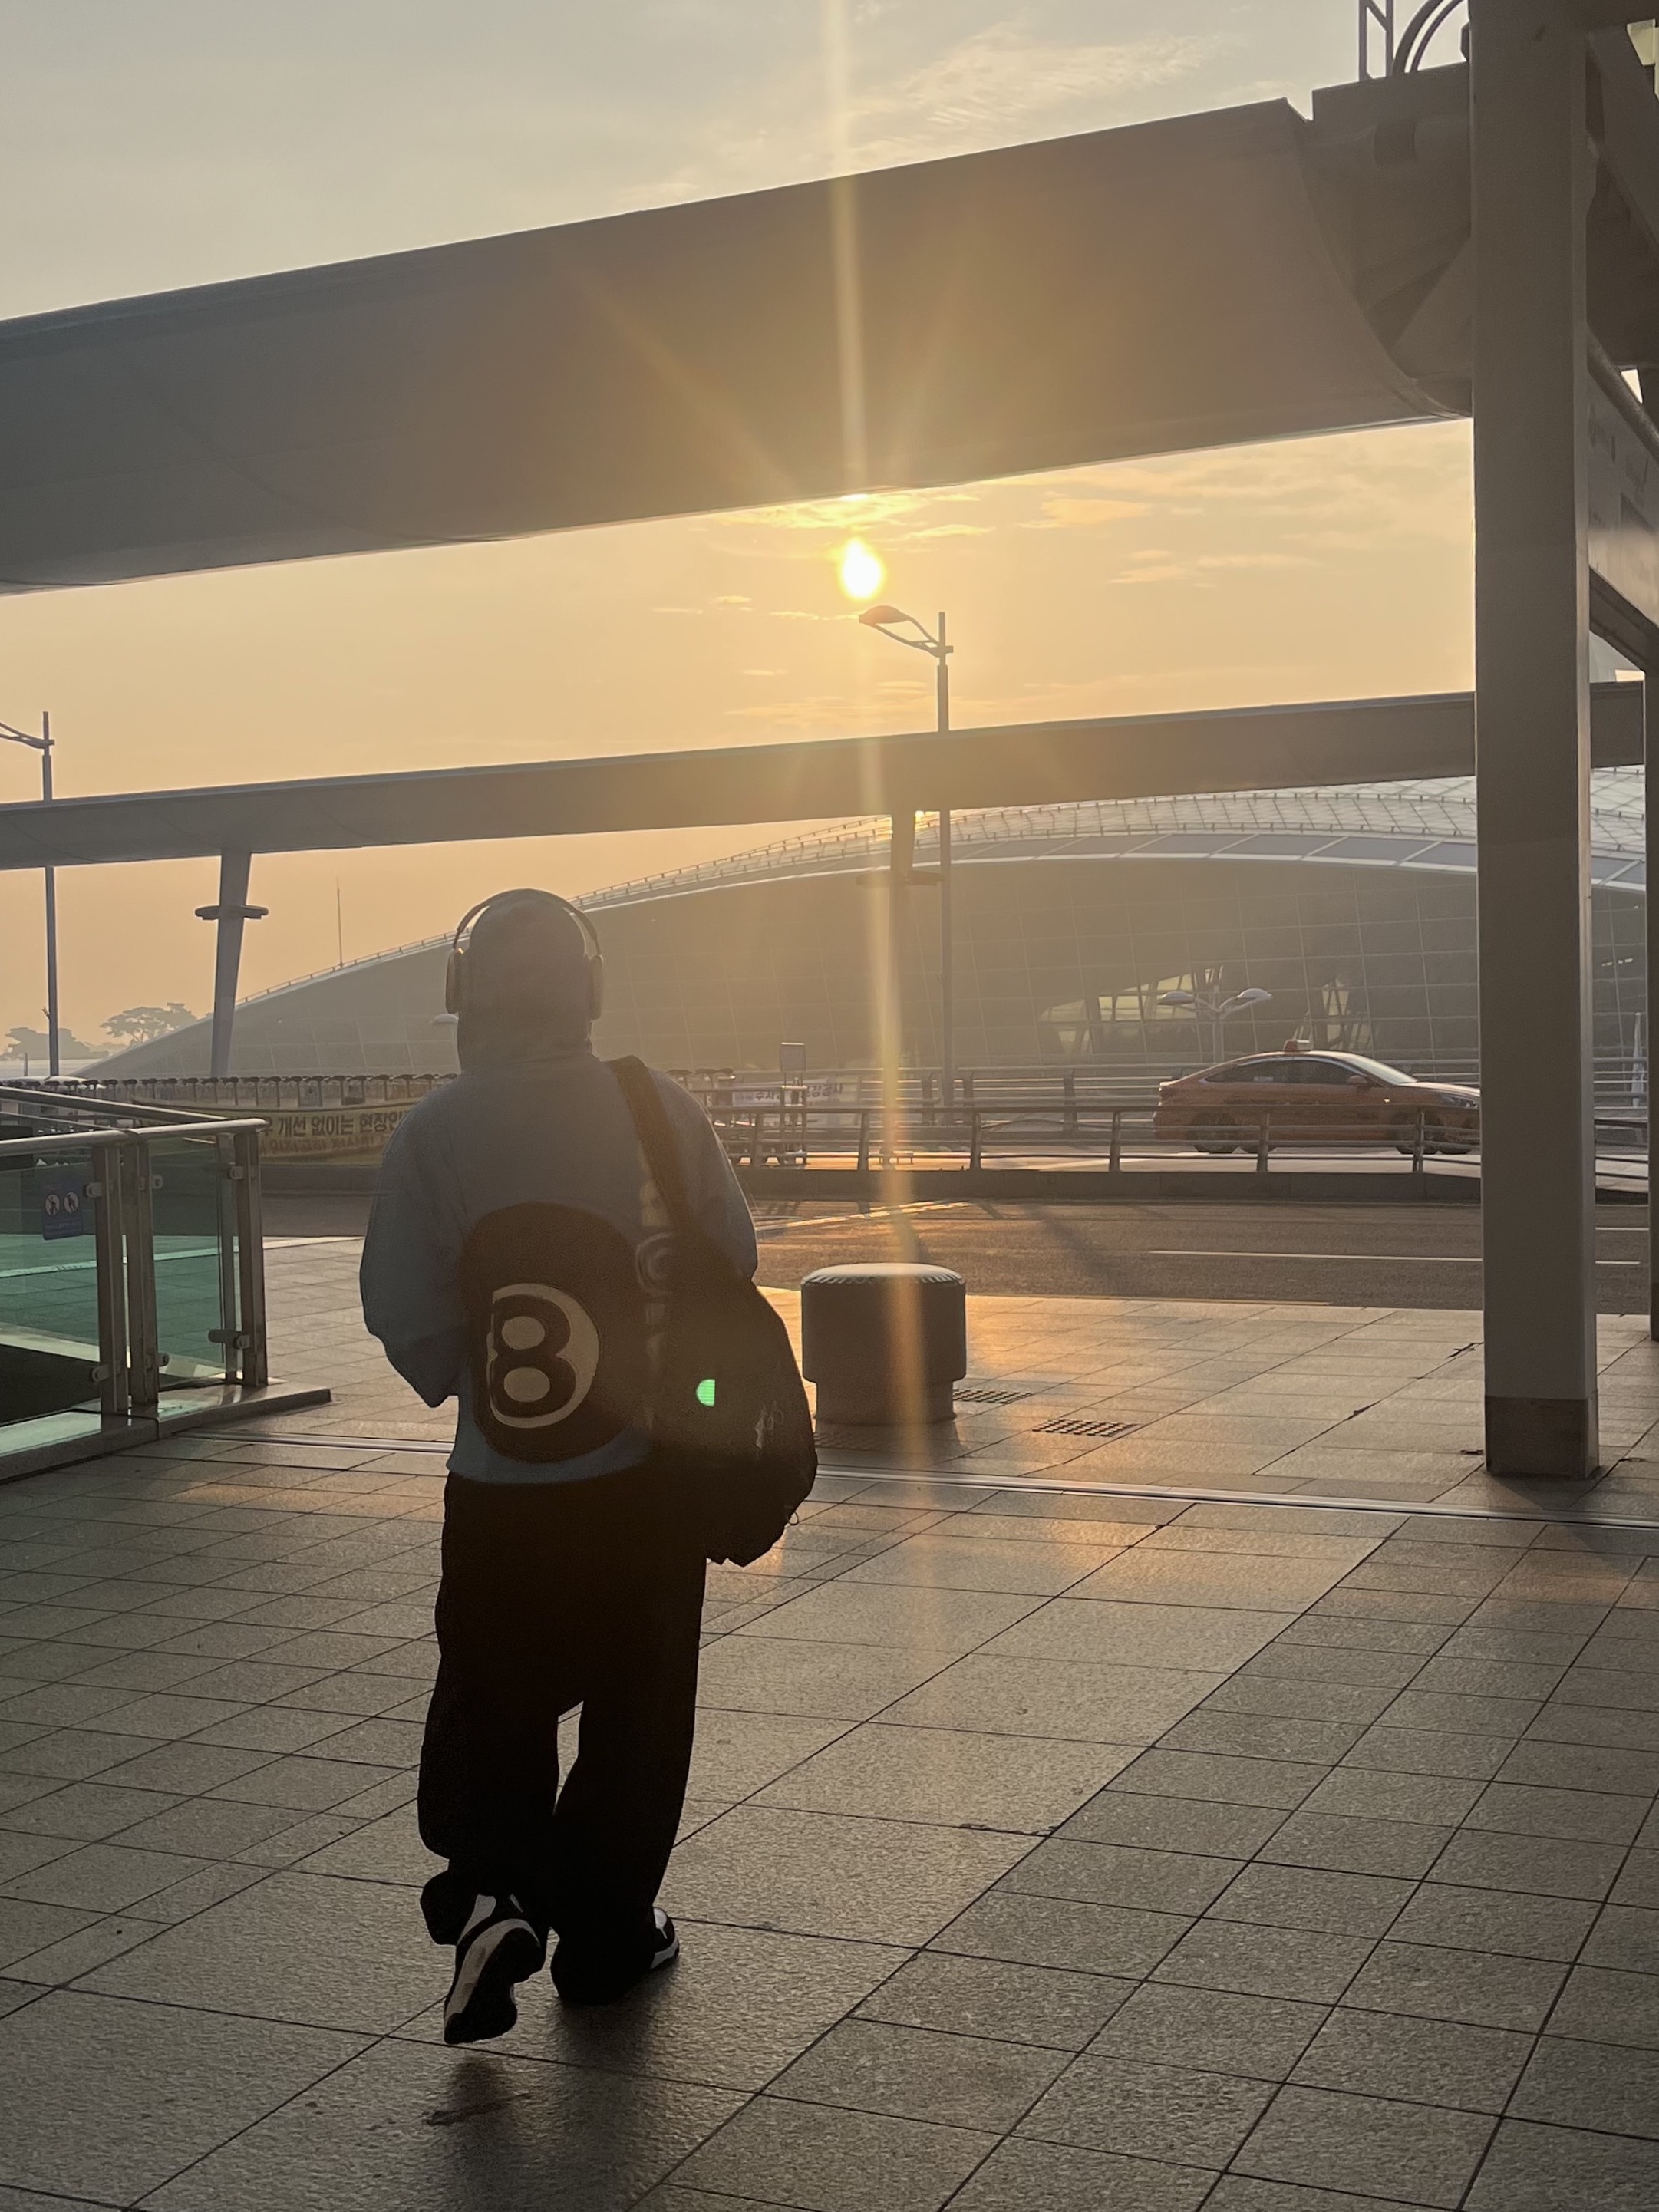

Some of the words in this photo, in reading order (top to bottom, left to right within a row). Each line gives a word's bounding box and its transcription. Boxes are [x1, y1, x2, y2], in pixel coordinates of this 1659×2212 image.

[278, 1116, 307, 1137] 개선
[311, 1115, 353, 1136] 없이는
[359, 1110, 407, 1133] 현장인
[491, 1294, 578, 1419] 8
